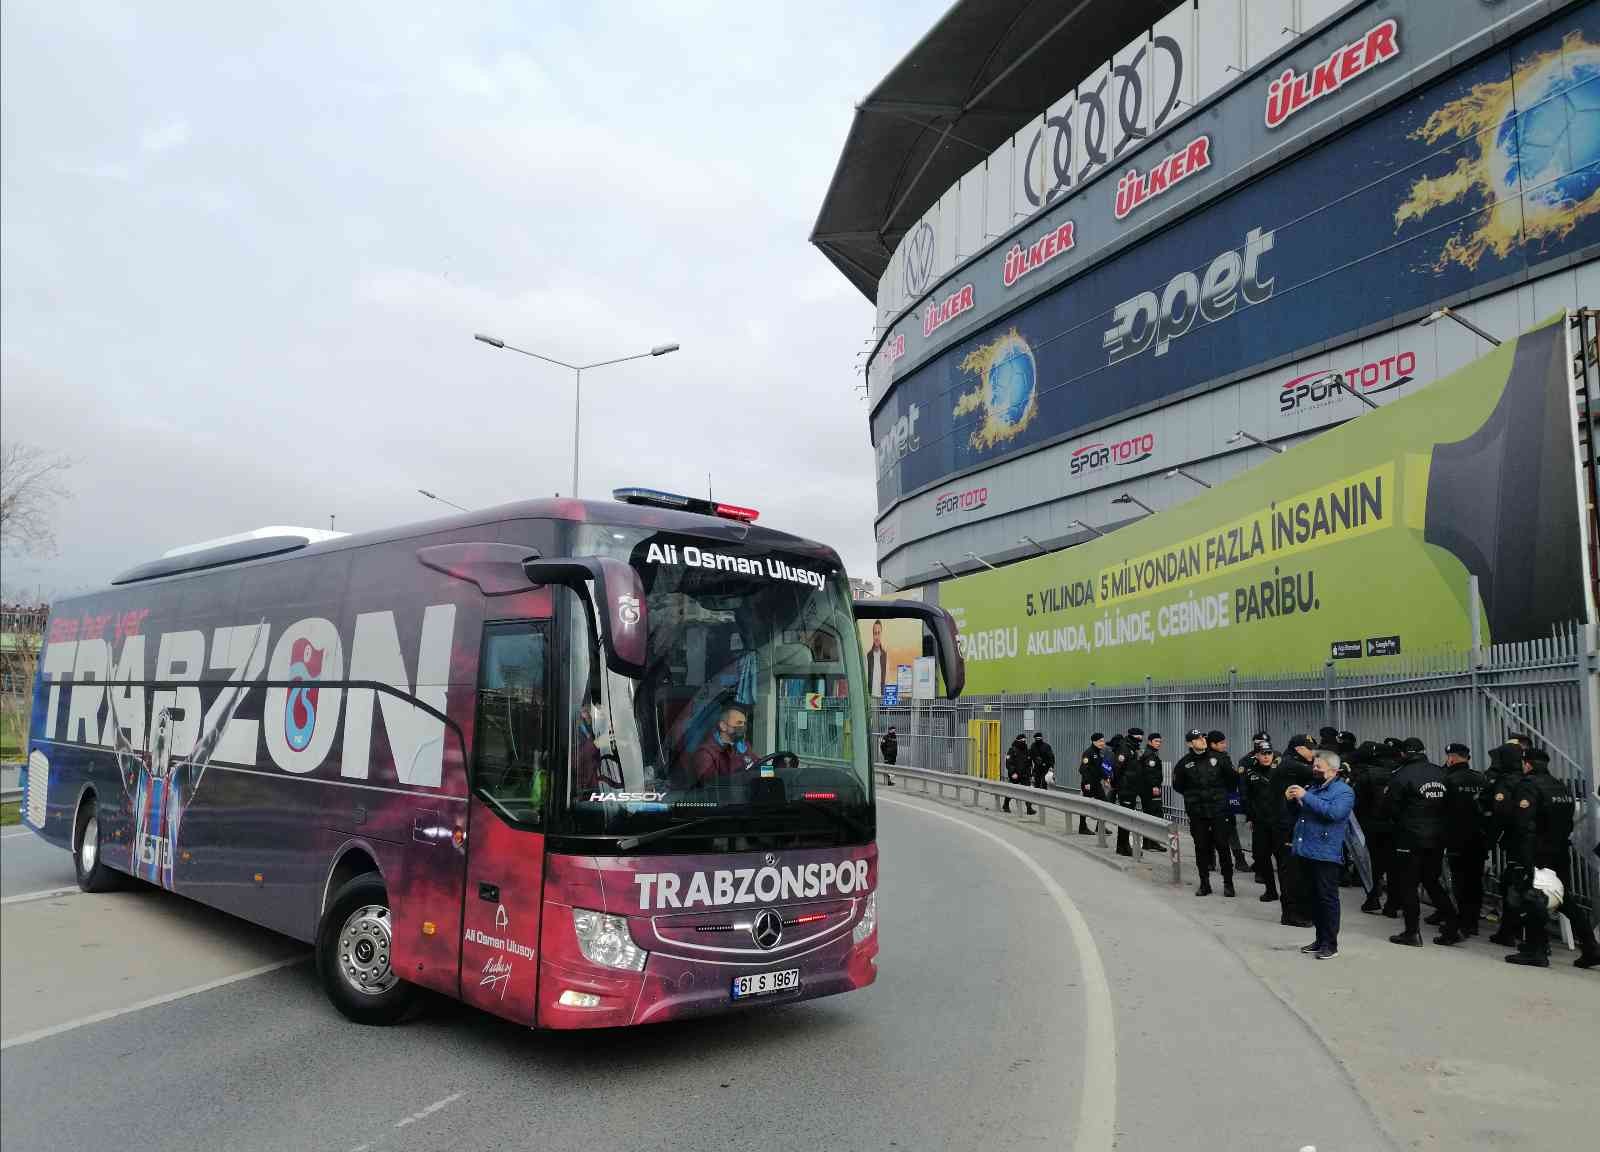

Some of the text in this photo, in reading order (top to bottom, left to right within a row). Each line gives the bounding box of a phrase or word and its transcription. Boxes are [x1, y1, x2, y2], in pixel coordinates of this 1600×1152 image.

[1265, 19, 1399, 129] ÜLKER
[1114, 136, 1212, 219] ÜLKER
[1003, 221, 1075, 287] ÜLKER
[923, 284, 974, 337] ÜLKER
[1103, 226, 1274, 366] opet
[646, 543, 826, 592] Ali Osman Ulusoy
[1026, 476, 1383, 617] 5. YILINDA 5 MİLYONDAN FAZLA İNSANIN
[1027, 566, 1320, 656] AKLINDA, DİLİNDE, CEBİNDE PARİBU.
[42, 603, 457, 788] TRABZON
[589, 792, 667, 802] HASSOY
[634, 858, 869, 911] TRABZONSPOR
[465, 928, 535, 961] Ali Osman Ulusoy
[740, 977, 753, 993] 61
[758, 975, 767, 990] S
[773, 970, 798, 988] 1967
